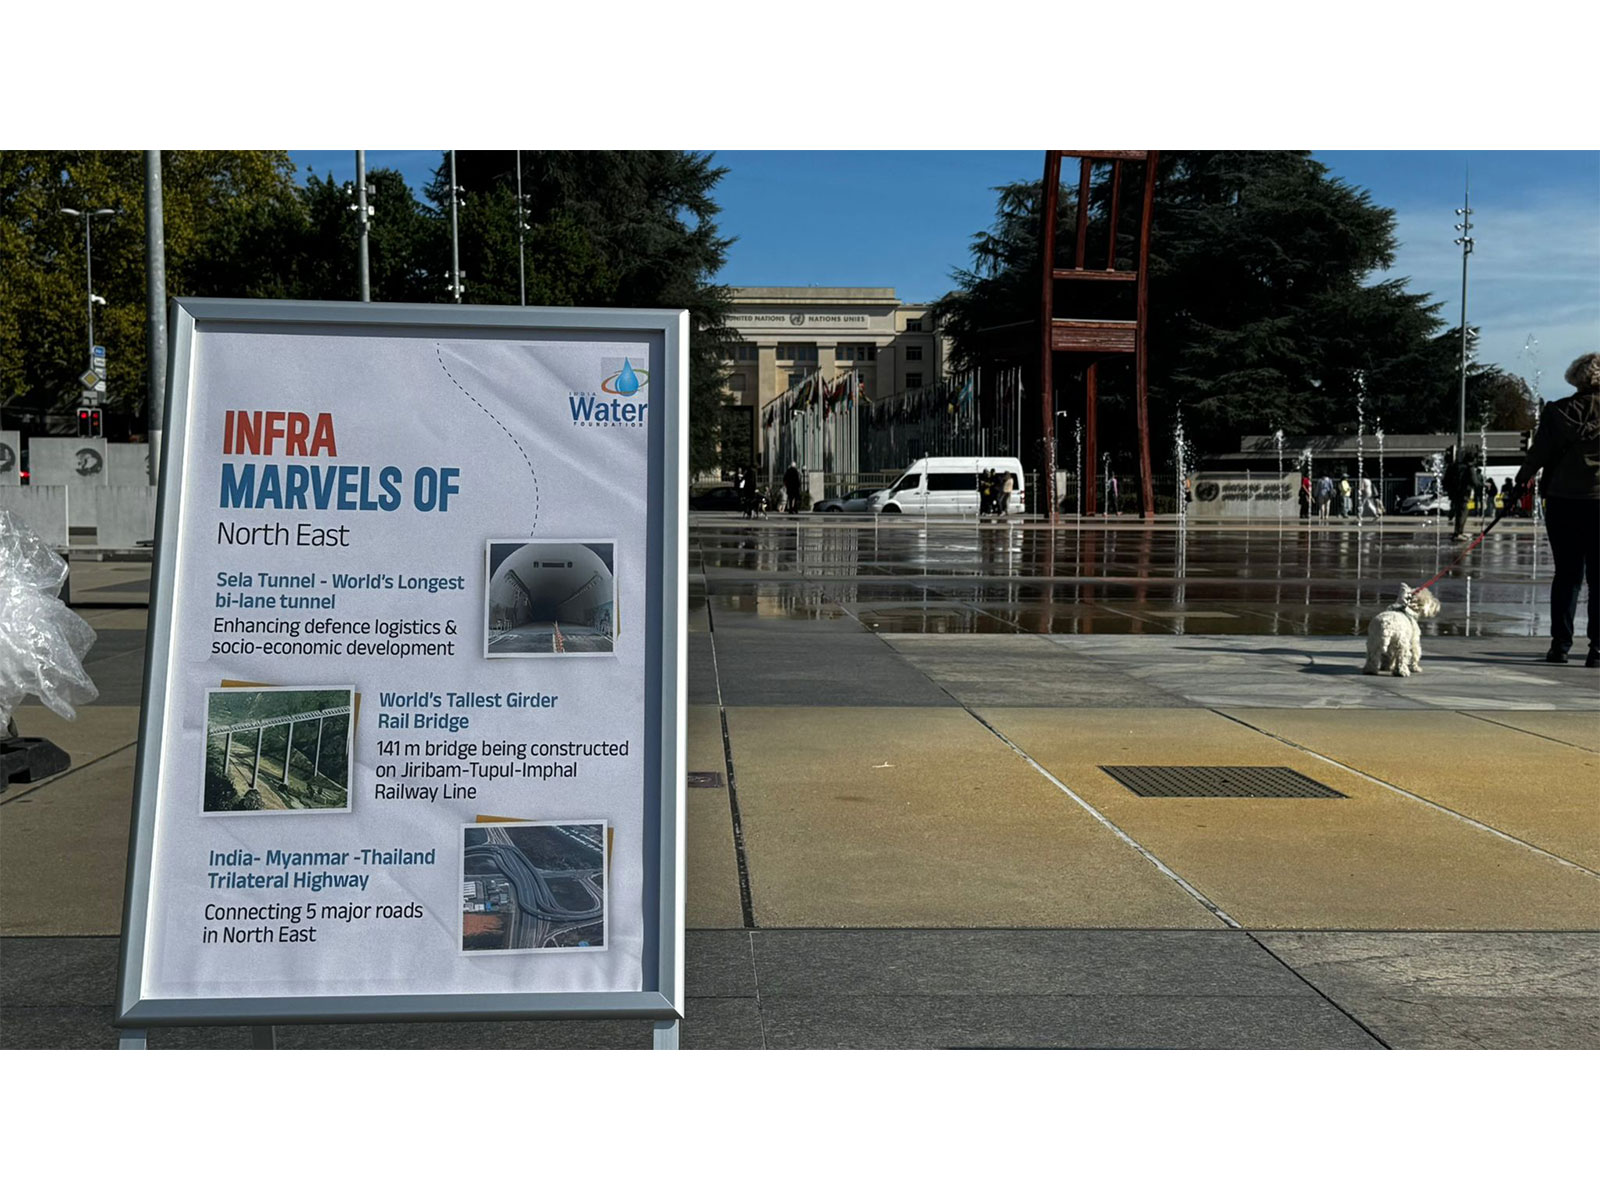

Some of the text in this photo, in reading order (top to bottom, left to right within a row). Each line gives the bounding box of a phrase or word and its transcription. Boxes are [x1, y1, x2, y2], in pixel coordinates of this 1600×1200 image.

[569, 396, 648, 422] Water
[222, 410, 337, 457] INFRA
[219, 464, 460, 512] MARVELS OF
[218, 522, 350, 547] North East
[217, 572, 254, 588] Sela
[258, 573, 316, 590] Tunnel
[332, 574, 394, 590] World’s
[398, 575, 465, 594] Longest
[216, 594, 336, 610] bi-lane tunnel
[214, 618, 458, 640] Enhancing defence logistics &
[212, 640, 455, 660] socio-economic development
[380, 692, 558, 709] World’s Tallest Girder
[378, 713, 469, 733] Rail Bridge
[377, 740, 628, 760] 141 m bridge being constructed
[376, 761, 578, 782] on Jiribam-Tupul-Imphal
[374, 783, 477, 802] Railway Line
[209, 848, 436, 870] India- Myanmar -Thailand
[208, 871, 370, 892] Trilateral Highway
[204, 902, 424, 923] Connecting 5 major roads
[202, 926, 317, 943] in North East
